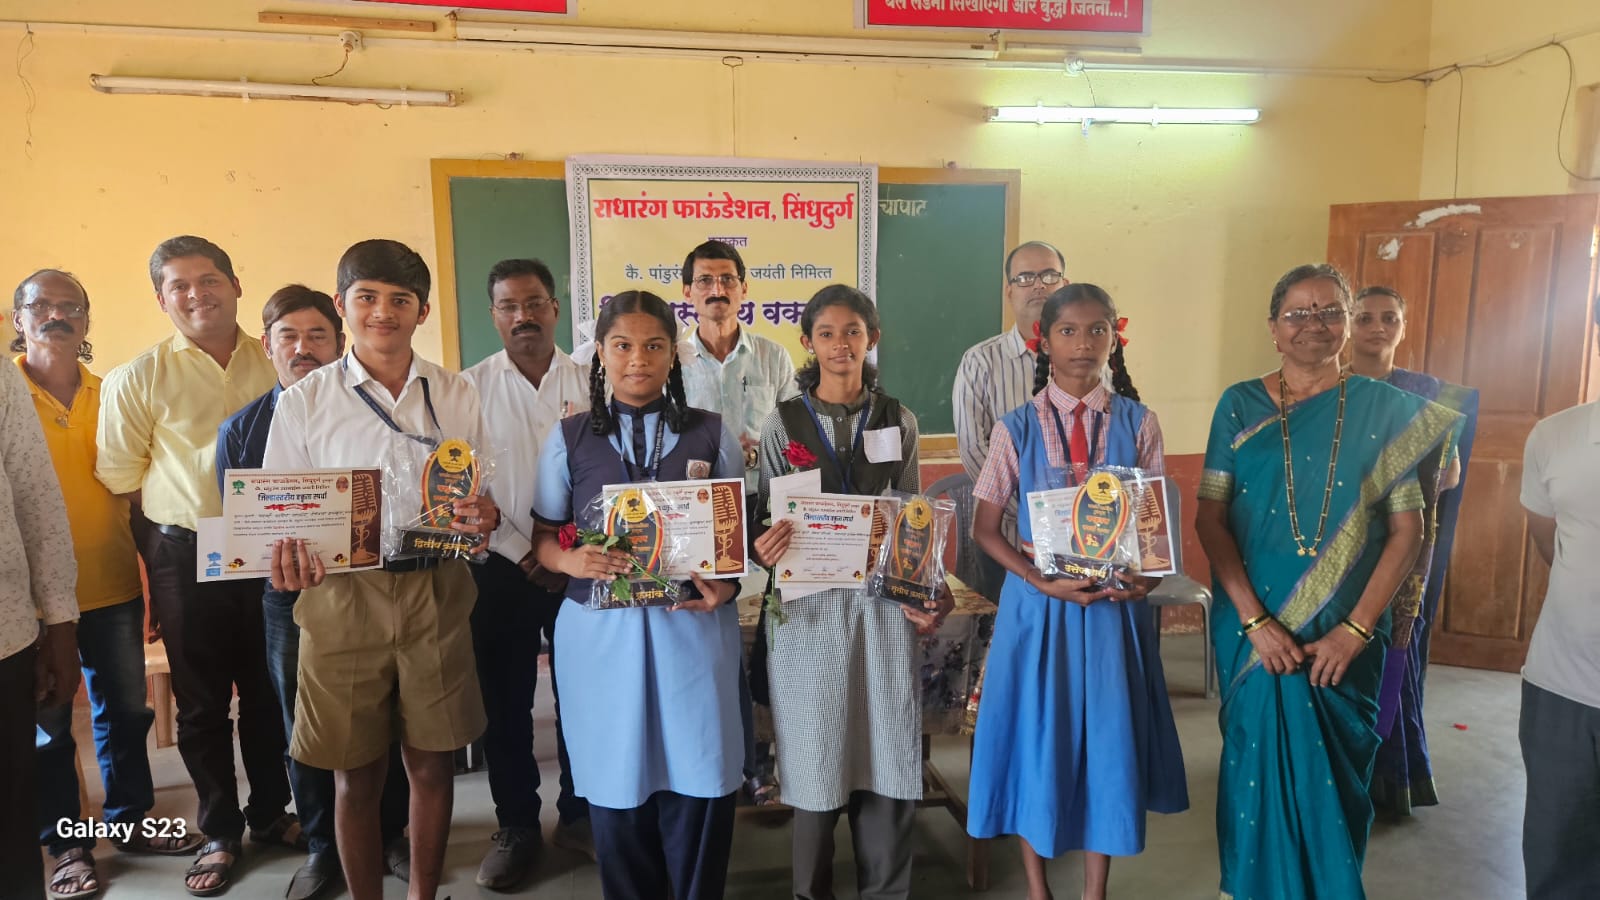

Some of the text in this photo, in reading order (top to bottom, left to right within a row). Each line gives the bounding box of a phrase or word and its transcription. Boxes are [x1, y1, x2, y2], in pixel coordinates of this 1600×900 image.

[593, 190, 855, 230] राधारंग फाऊंडेशन, सिंधुदुर्ग
[625, 263, 832, 285] कै. पांडुरं जयंती निमित्त
